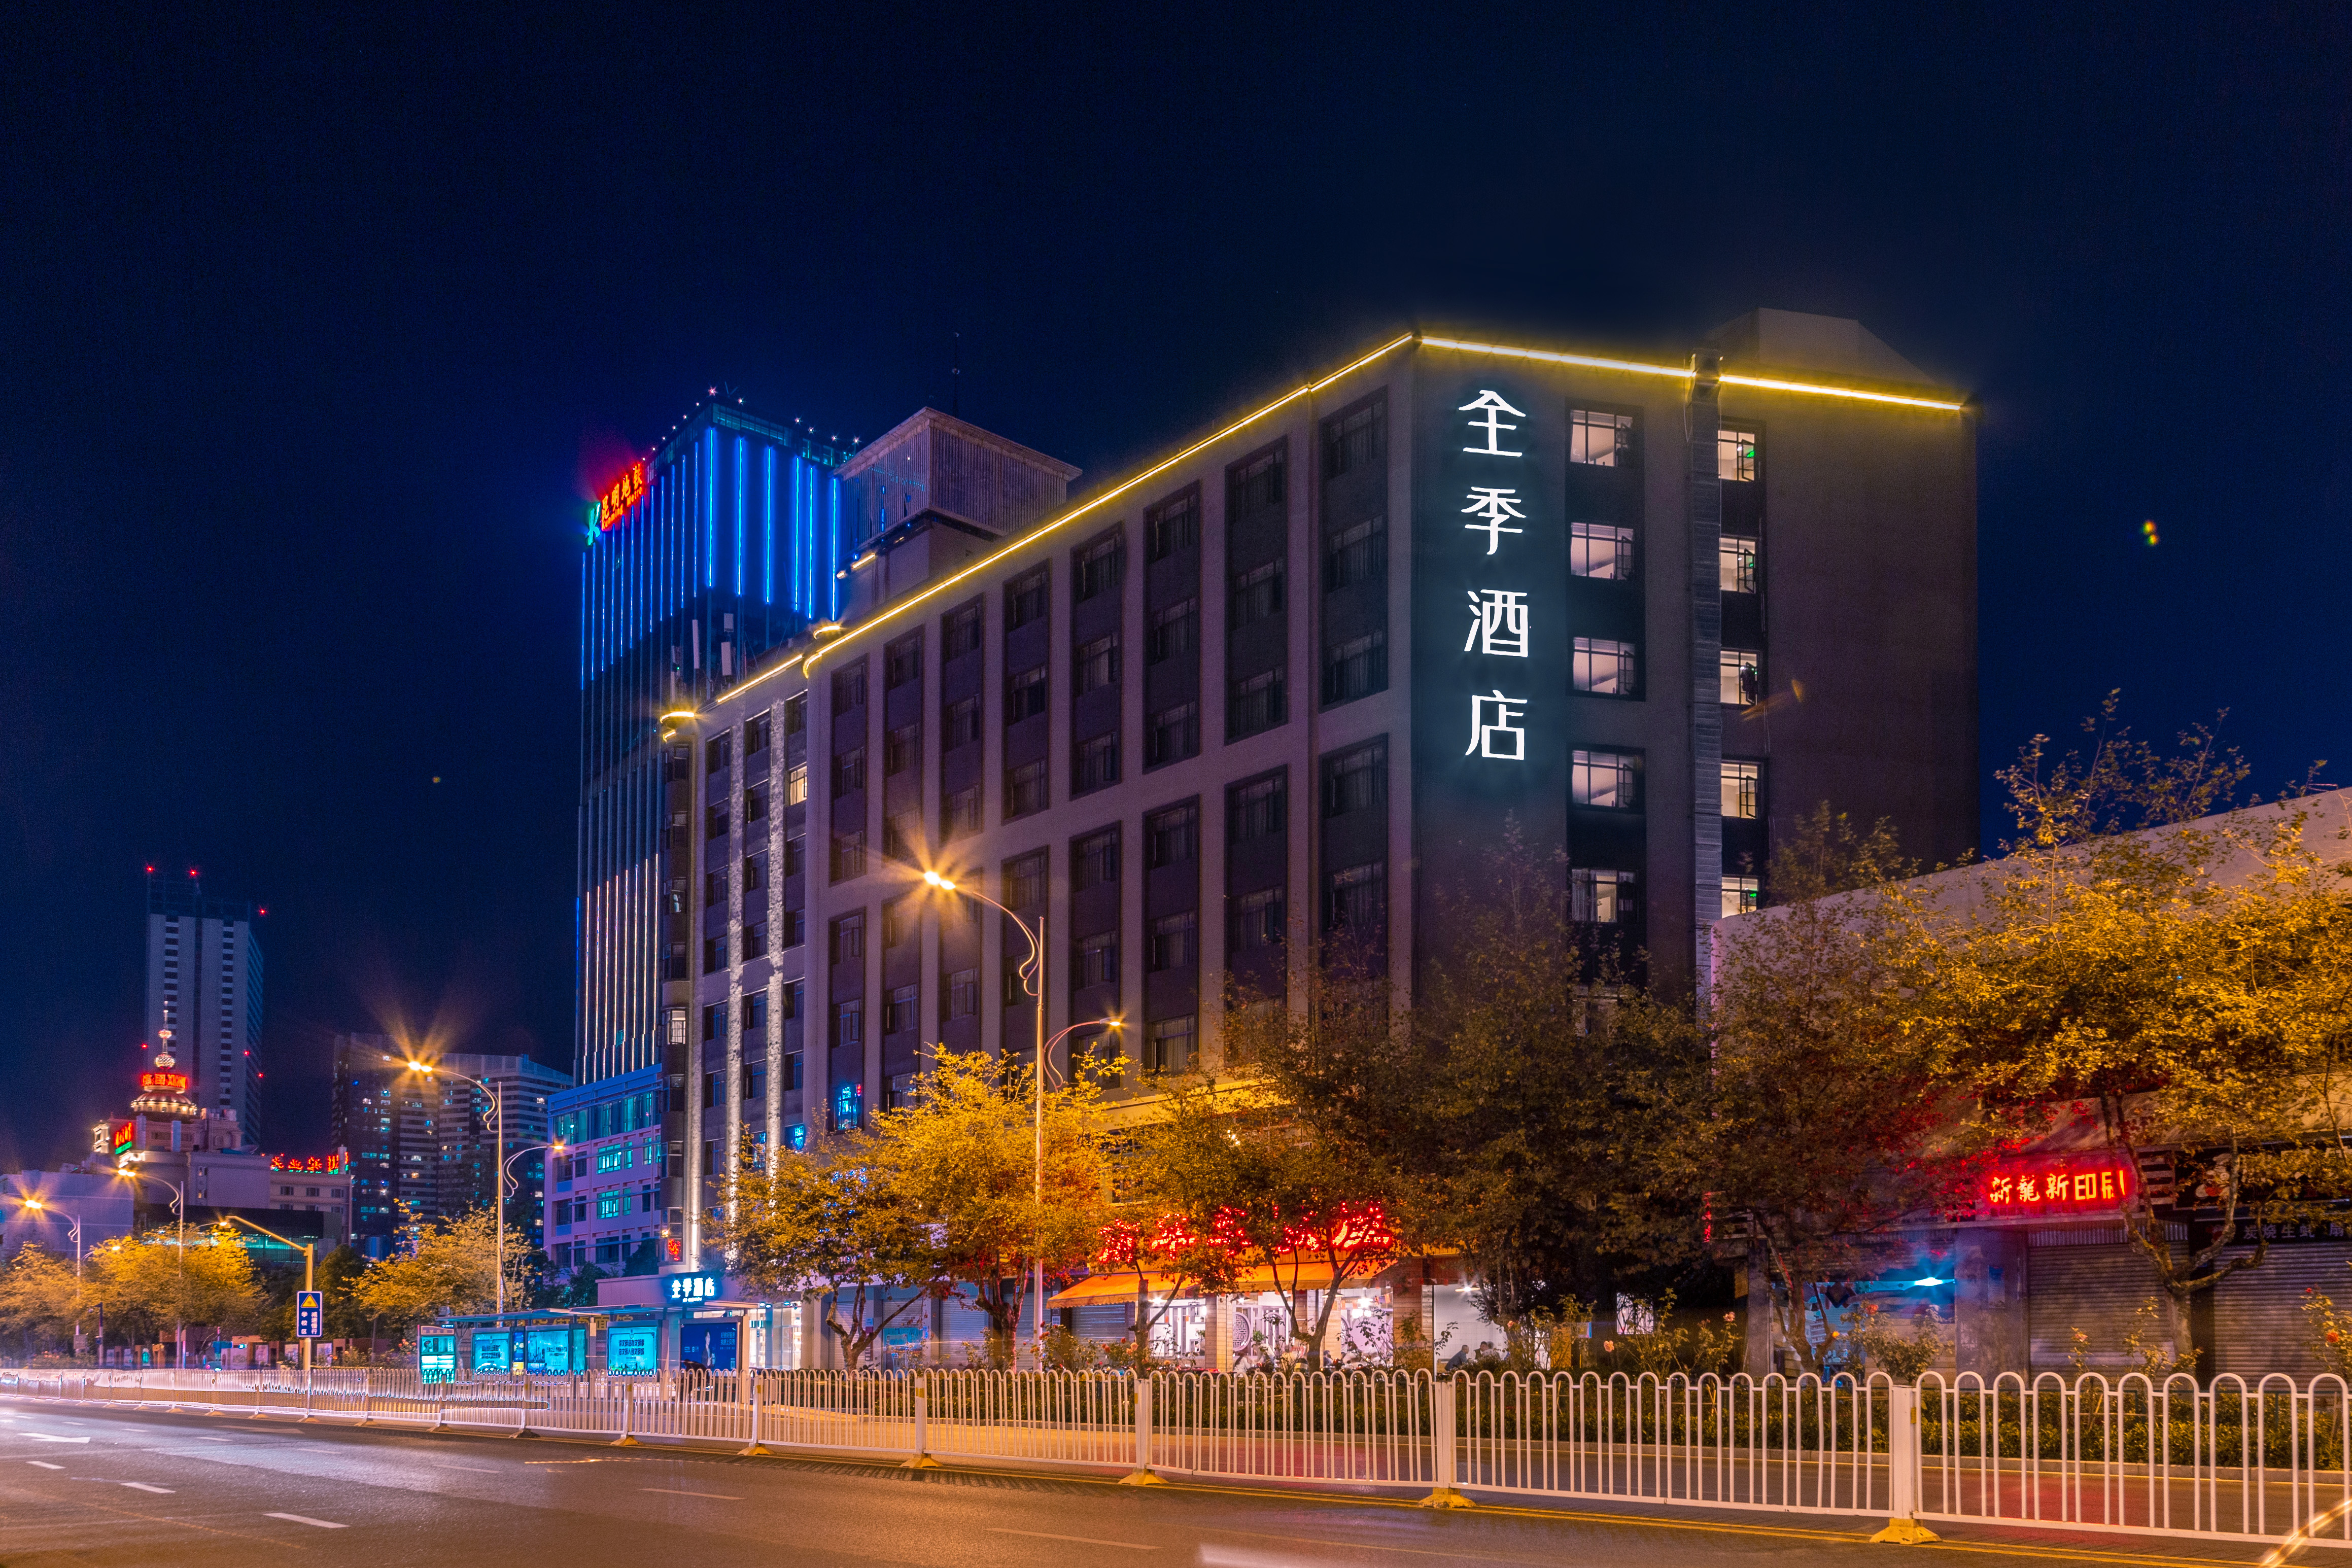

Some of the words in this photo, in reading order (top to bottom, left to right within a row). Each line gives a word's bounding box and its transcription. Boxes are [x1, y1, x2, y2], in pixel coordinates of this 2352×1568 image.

[1459, 390, 1529, 760] 全季酒店
[671, 1277, 715, 1298] 全季酒店
